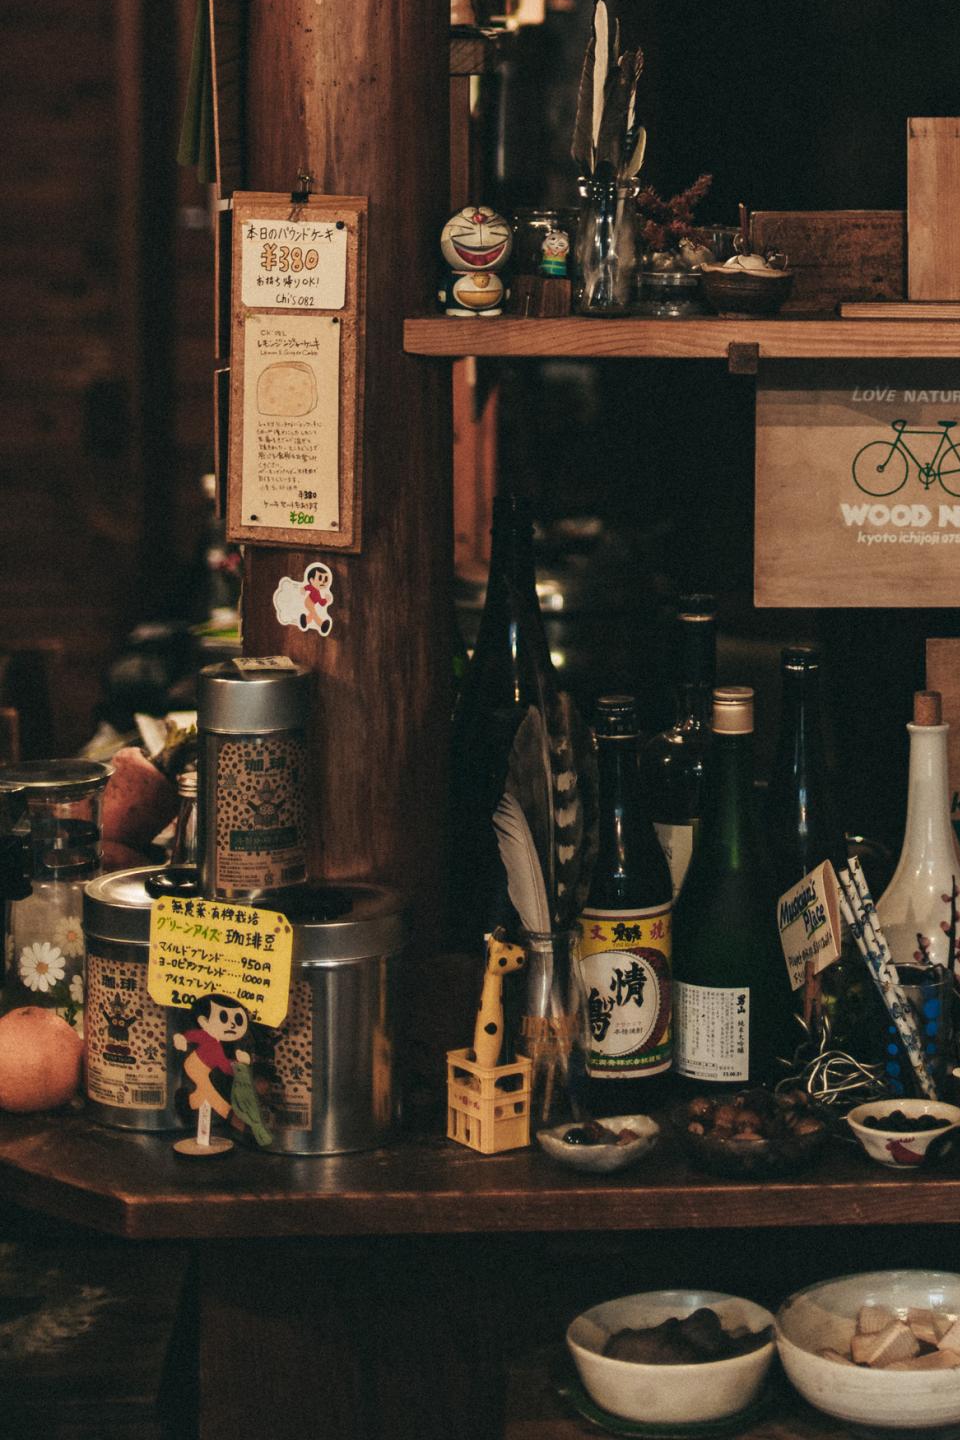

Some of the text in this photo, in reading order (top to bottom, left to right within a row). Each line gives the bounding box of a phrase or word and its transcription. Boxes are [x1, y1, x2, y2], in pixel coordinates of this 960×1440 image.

[247, 225, 334, 242] 本日のパウンドケーキ
[260, 243, 320, 274] ¥380
[852, 386, 897, 402] LOVE
[289, 511, 315, 525] ¥800
[840, 504, 932, 527] WOOD
[858, 532, 898, 545] kyoto
[899, 532, 940, 545] ichijoji
[224, 928, 276, 953] 珈琲豆
[159, 941, 271, 973] マイルドブレンド 950円
[165, 973, 222, 993] アイスブレンド
